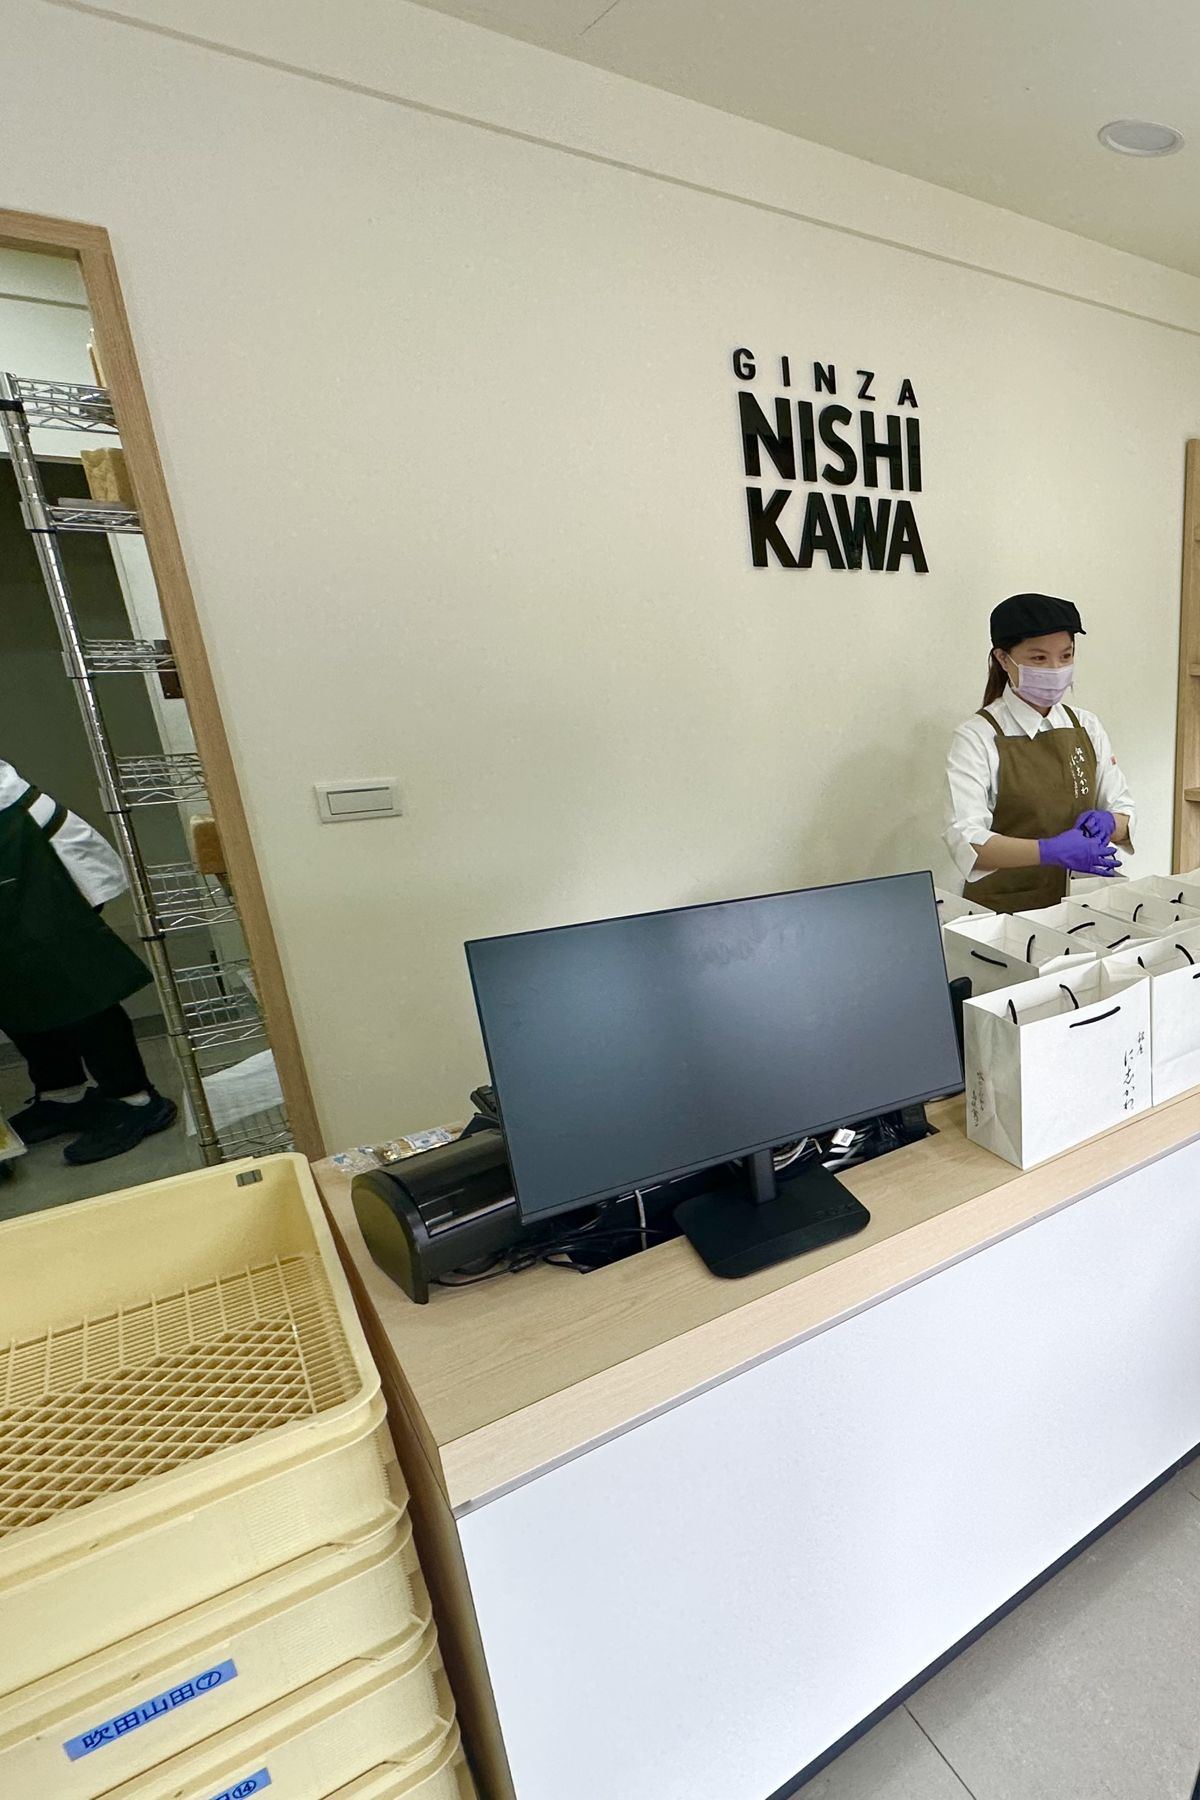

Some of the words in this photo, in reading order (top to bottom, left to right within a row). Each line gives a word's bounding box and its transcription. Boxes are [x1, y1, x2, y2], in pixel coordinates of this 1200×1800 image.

[732, 347, 919, 408] GINZA
[738, 391, 922, 492] NISHI
[746, 486, 929, 573] KAWA
